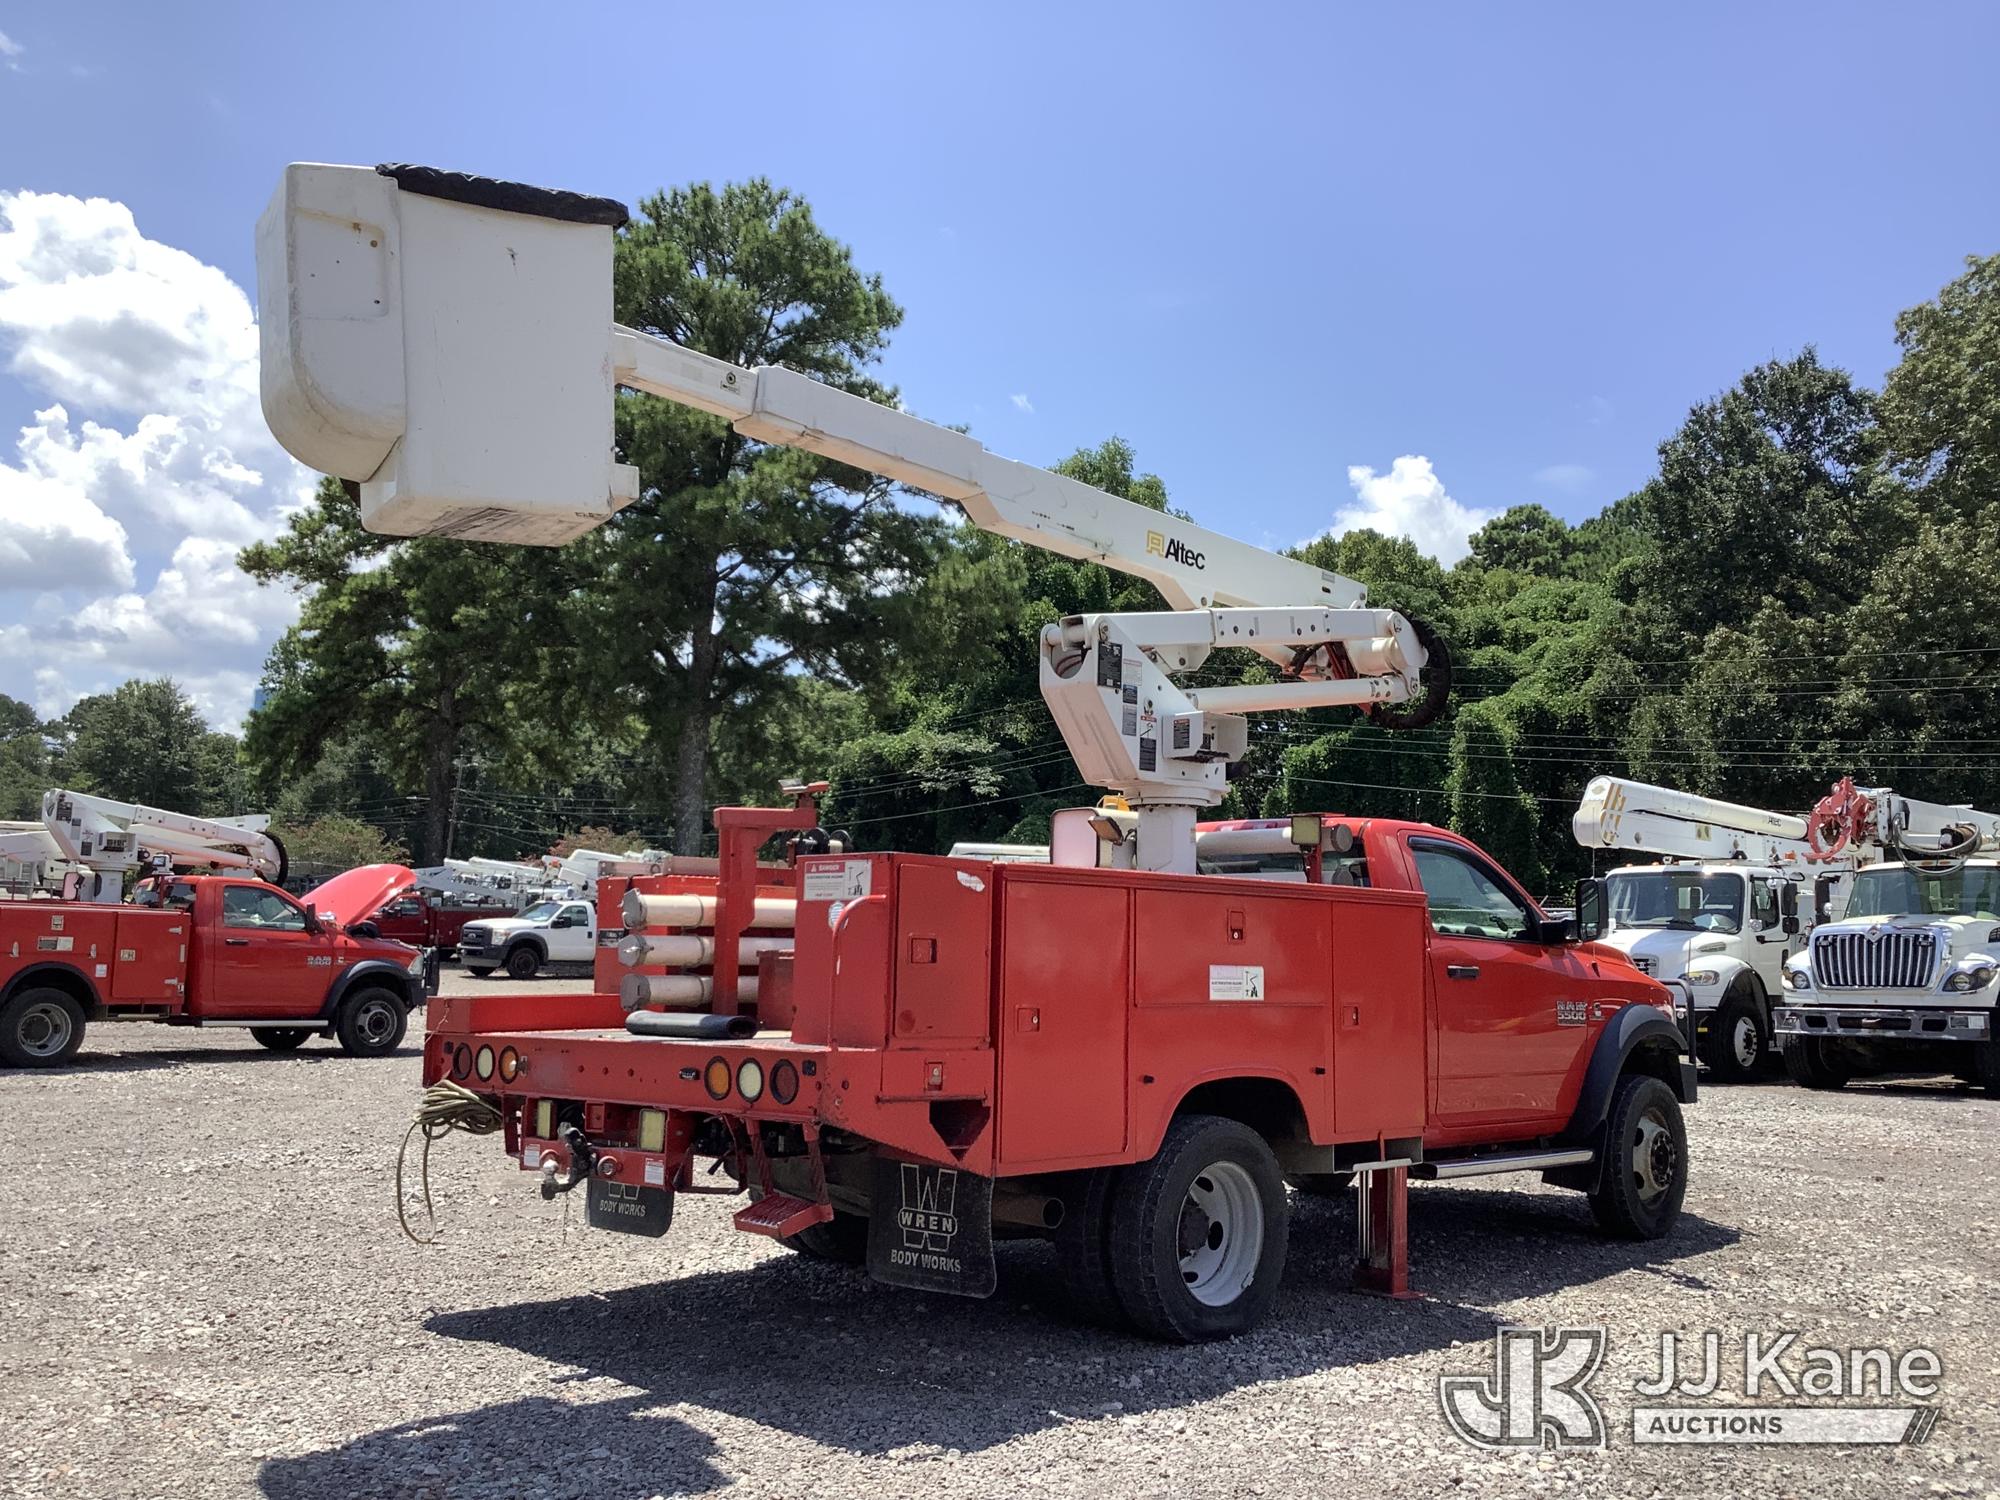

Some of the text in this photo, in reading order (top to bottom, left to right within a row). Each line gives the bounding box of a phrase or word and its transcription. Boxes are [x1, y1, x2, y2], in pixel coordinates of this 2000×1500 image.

[1165, 538, 1206, 570] Altec
[1557, 1010, 1587, 1020] 5500
[600, 1199, 647, 1217] BODY WORKS
[901, 1211, 953, 1232] WREN
[890, 1249, 961, 1273] BODY WORKS
